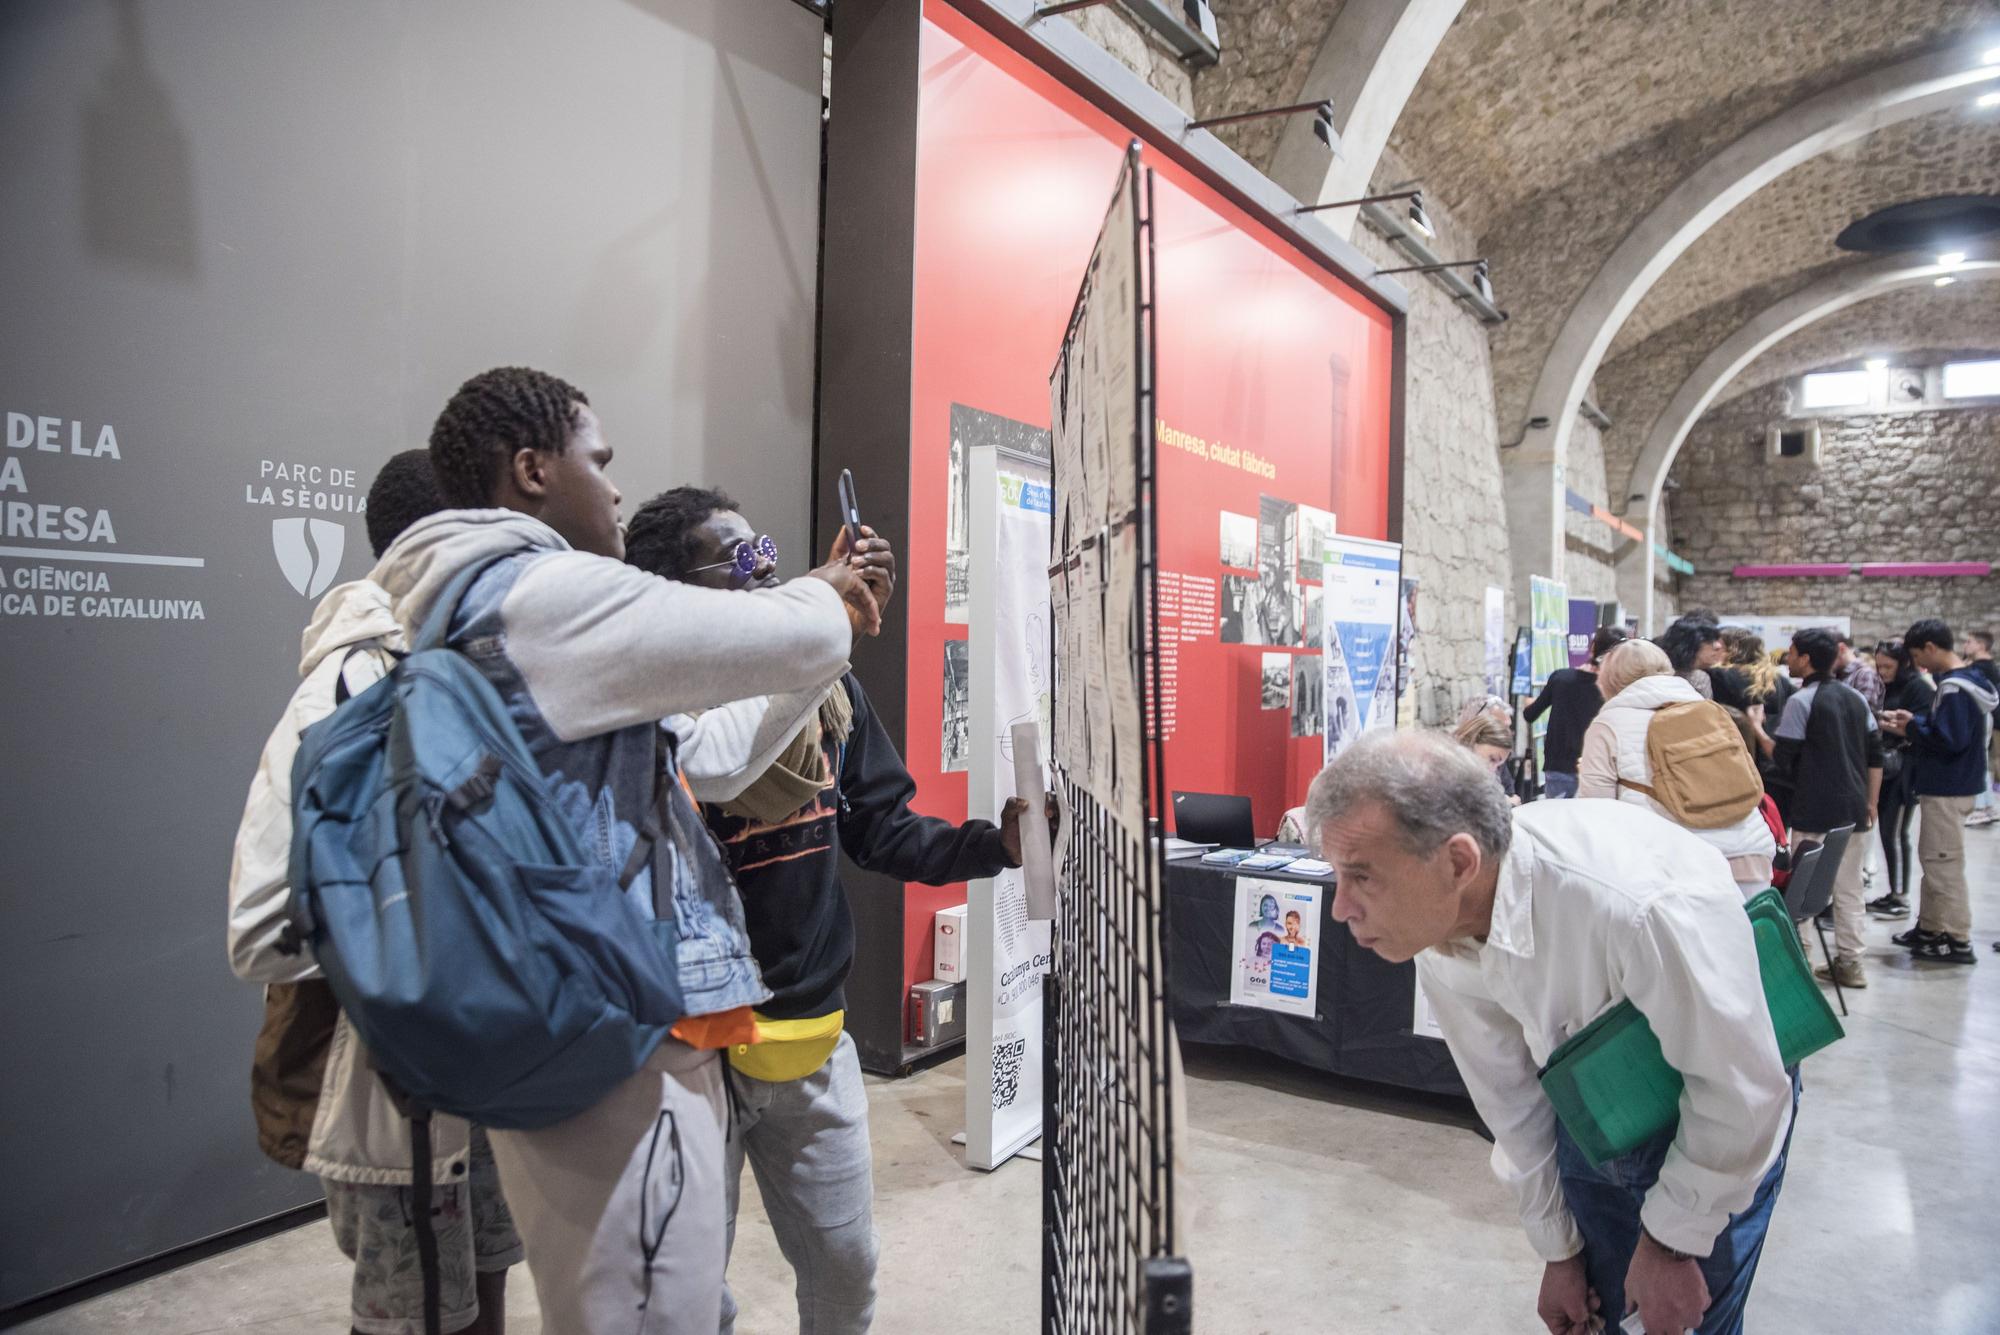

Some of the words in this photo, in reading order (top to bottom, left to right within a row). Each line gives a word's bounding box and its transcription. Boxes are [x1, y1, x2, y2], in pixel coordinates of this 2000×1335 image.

[7, 412, 61, 452] DE
[71, 420, 121, 460] LA
[1155, 418, 1209, 462] Manresa,
[1210, 440, 1241, 468] ciutat
[1242, 450, 1276, 480] fàbrica
[261, 459, 322, 484] PARC
[330, 468, 356, 488] DE
[246, 484, 275, 505] LA
[281, 484, 368, 513] SÈQUIA
[0, 501, 118, 544] RESA
[13, 566, 110, 592] CIÈNCIA
[0, 593, 38, 616] CA
[44, 595, 76, 617] DE
[80, 597, 206, 620] CATALUNYA
